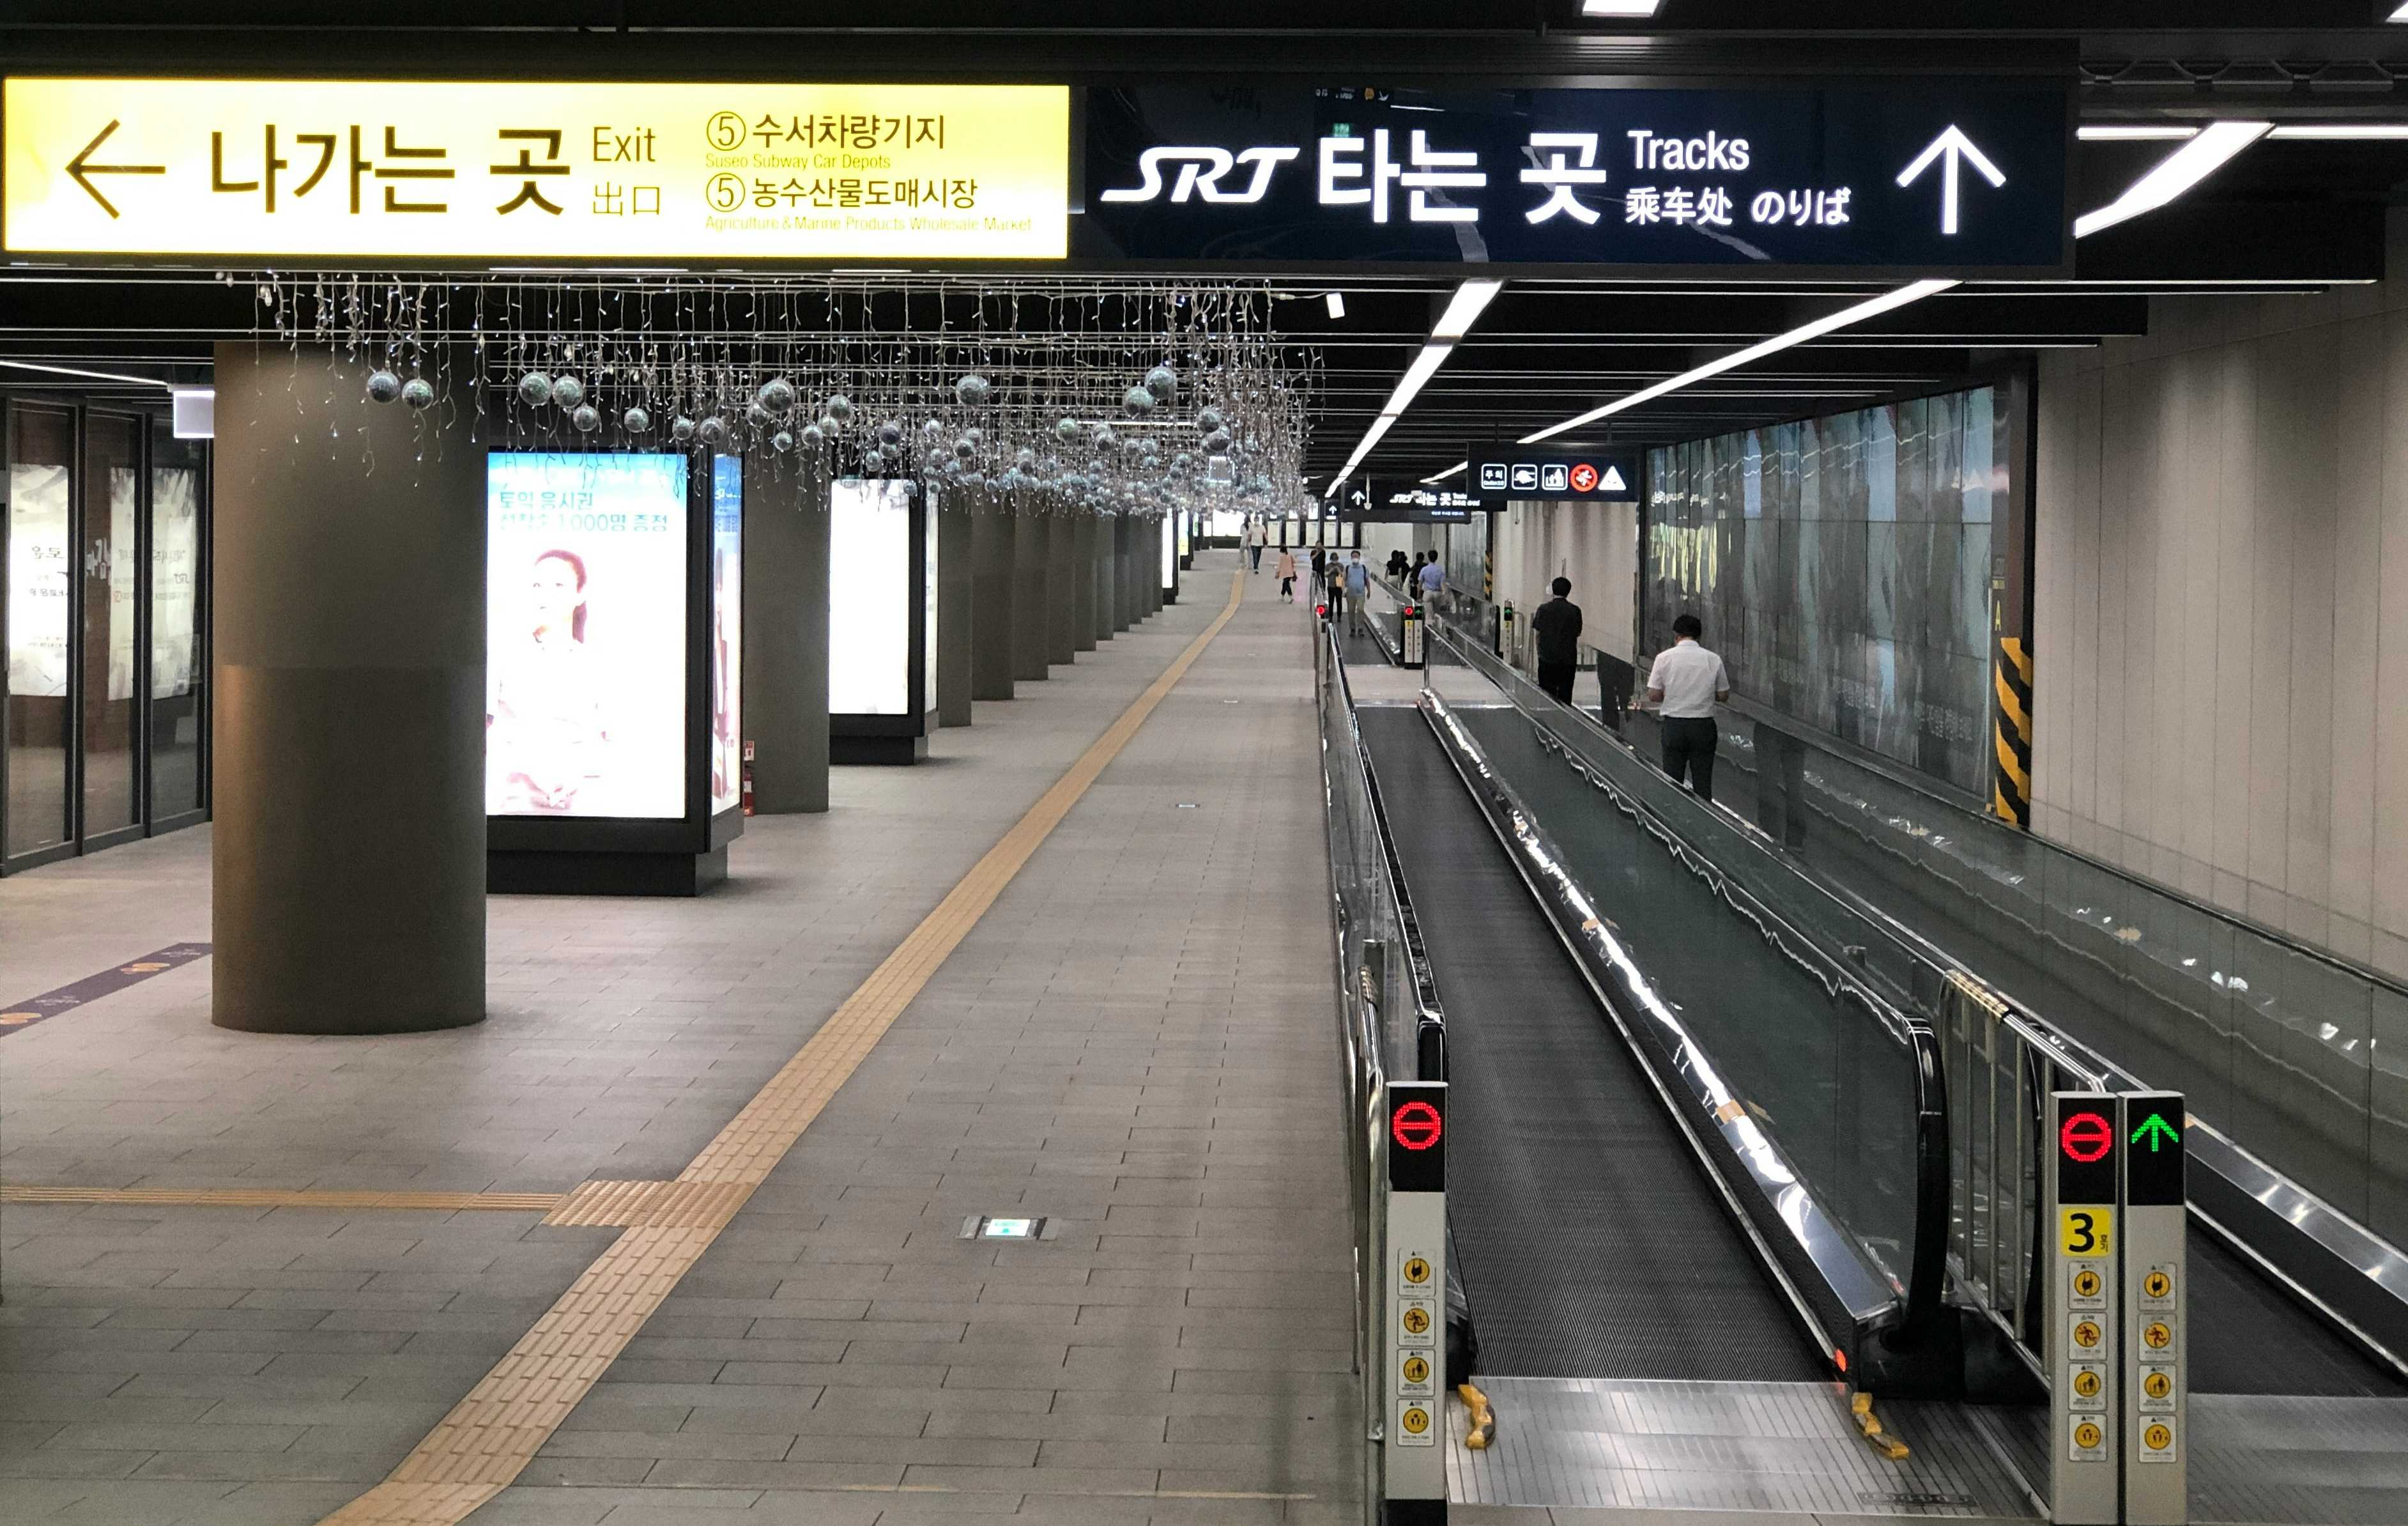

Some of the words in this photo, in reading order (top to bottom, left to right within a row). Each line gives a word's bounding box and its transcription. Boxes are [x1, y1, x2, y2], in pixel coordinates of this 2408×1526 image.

[593, 127, 656, 163] Exit
[753, 114, 945, 150] 수서차량기지
[706, 153, 748, 168] Suseo
[753, 153, 808, 171] Subway
[813, 153, 837, 168] Car
[843, 153, 891, 171] Depots
[1627, 130, 1750, 171] Tracks
[211, 124, 456, 215] 나가는
[489, 129, 571, 216] 곳
[1100, 146, 1301, 203] SRT
[1318, 128, 1487, 224] 타는
[1520, 132, 1607, 225] 곳
[593, 181, 661, 216] 出口
[752, 178, 978, 209] 농수산물도매시장
[1625, 186, 1733, 226] 乘车处
[1751, 187, 1852, 226] のりば
[705, 216, 779, 233] Agriculture
[782, 217, 793, 230] &
[795, 216, 841, 231] Marine
[845, 216, 905, 231] Products
[909, 217, 979, 231] Wholesale
[984, 217, 1032, 231] Market
[500, 490, 534, 509] 토익
[541, 490, 594, 511] 응시권
[633, 514, 668, 532] 증정
[2068, 1212, 2095, 1253] 3
